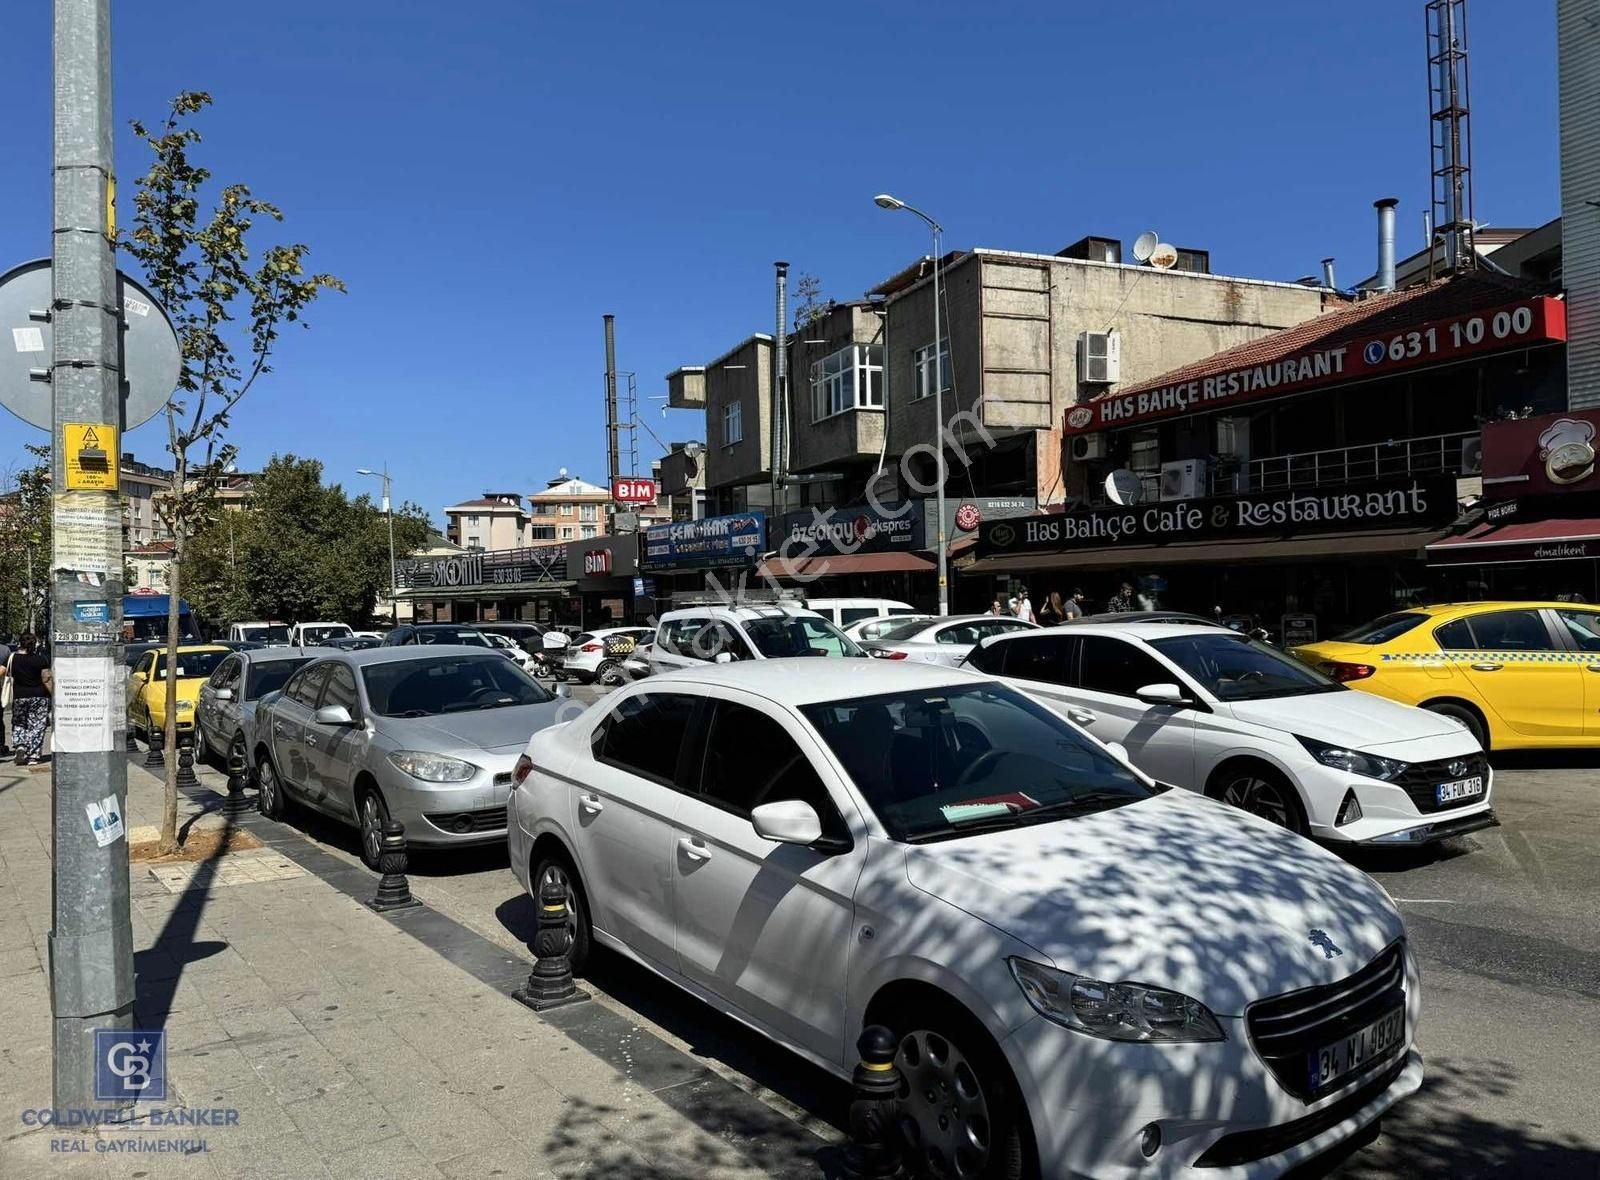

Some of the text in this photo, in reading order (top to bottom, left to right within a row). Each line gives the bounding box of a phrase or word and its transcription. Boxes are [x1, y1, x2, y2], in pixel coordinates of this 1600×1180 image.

[1100, 306, 1532, 422] HAS BAHÇE RESTAURANT 631 10 00
[618, 482, 651, 498] BİM
[791, 519, 911, 543] özsaray ekspres
[1026, 520, 1060, 542] Has
[1064, 513, 1137, 541] Bahçe
[1143, 503, 1204, 533] Cafe
[1211, 505, 1229, 527] &
[585, 551, 606, 573] BİM
[1441, 778, 1481, 799] 34 FUK 316
[1320, 1048, 1339, 1081] 34
[1347, 1033, 1365, 1070] NJ
